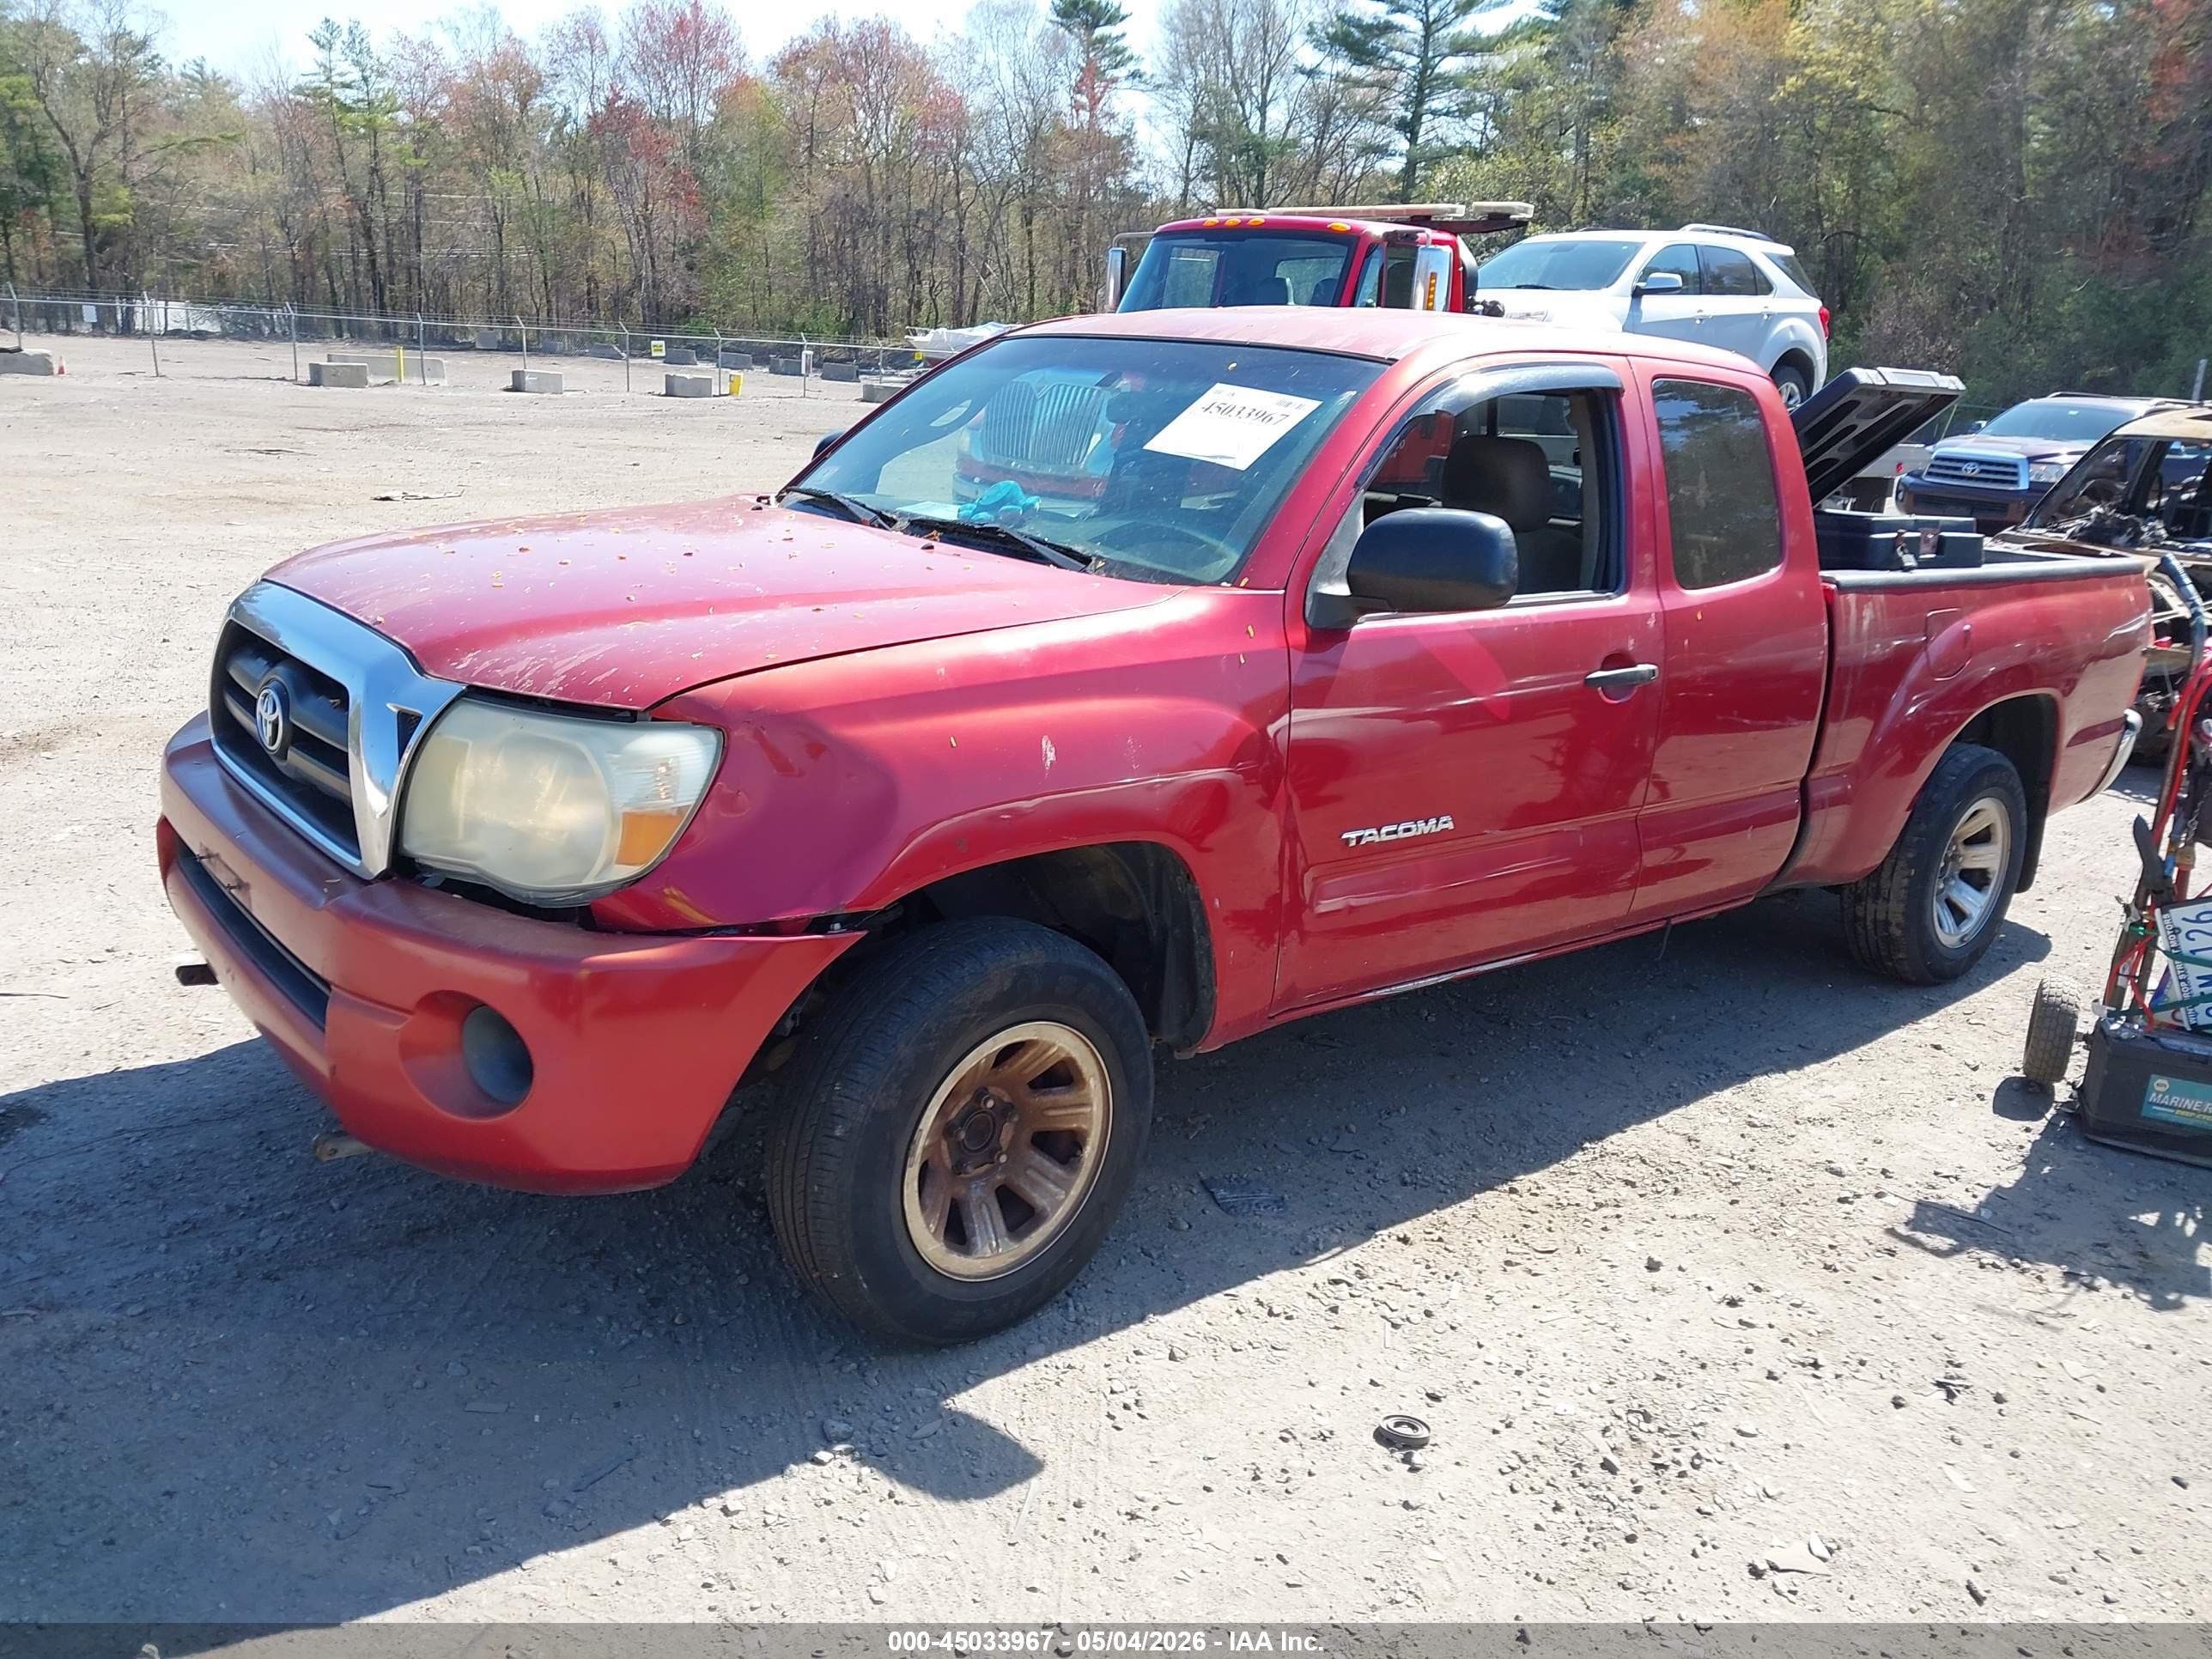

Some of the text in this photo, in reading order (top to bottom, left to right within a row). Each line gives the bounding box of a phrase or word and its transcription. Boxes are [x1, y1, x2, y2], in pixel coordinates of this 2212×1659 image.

[1202, 401, 1290, 425] 45033967
[1341, 815, 1455, 848] TACOMA
[2163, 914, 2179, 947] MOTORS
[2149, 1092, 2203, 1112] MARINE
